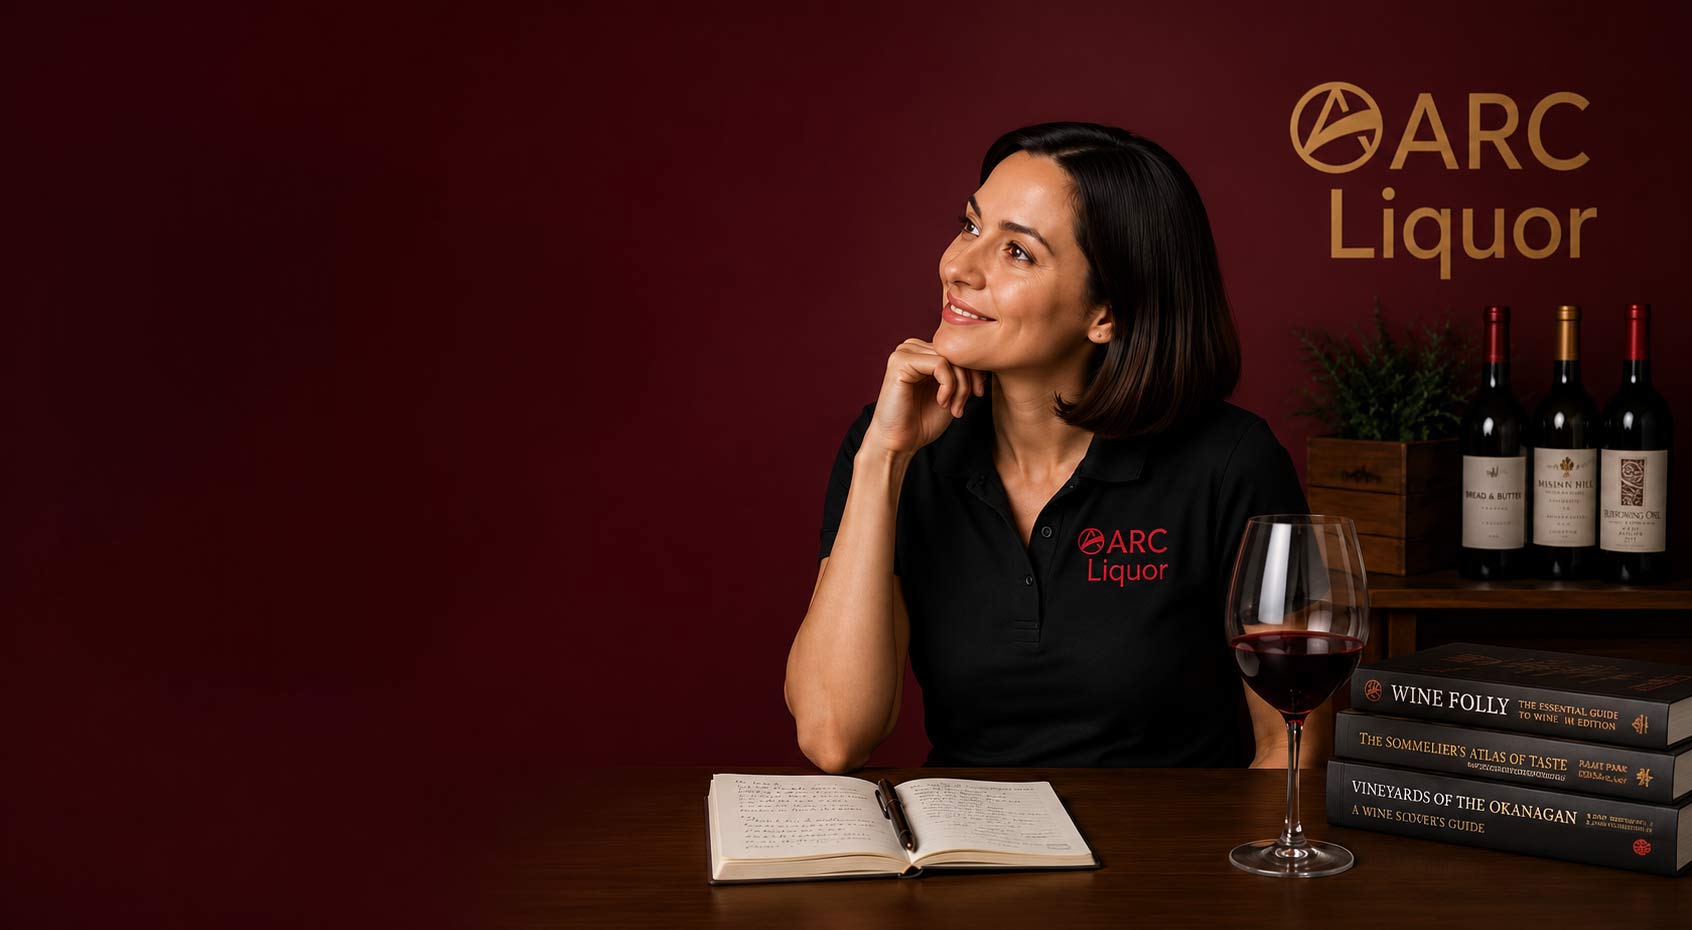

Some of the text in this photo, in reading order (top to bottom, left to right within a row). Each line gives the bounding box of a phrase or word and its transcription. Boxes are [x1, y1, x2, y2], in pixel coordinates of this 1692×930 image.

[1389, 91, 1591, 171] ARC
[1330, 187, 1597, 280] Liquor
[1106, 528, 1168, 554] ARC
[1088, 558, 1168, 588] Liquor
[1391, 684, 1510, 716] WINE FOLLY
[1518, 700, 1619, 720] THE ESSENTIAL GUIDE
[1518, 710, 1531, 720] TO
[1534, 712, 1559, 723] WINE
[1577, 718, 1616, 731] EDITION
[1385, 736, 1466, 758] SOMMELIER'S
[1469, 748, 1507, 763] ATLAS
[1509, 753, 1526, 766] OF
[1529, 754, 1568, 771] TASTE
[1352, 780, 1431, 804] VINEYARDS
[1433, 792, 1453, 807] OF
[1456, 795, 1485, 812] THE
[1489, 800, 1578, 825] OKANAGAN
[1352, 804, 1359, 815] A
[1362, 805, 1393, 819] WINE
[1448, 818, 1486, 834] GUIDE
